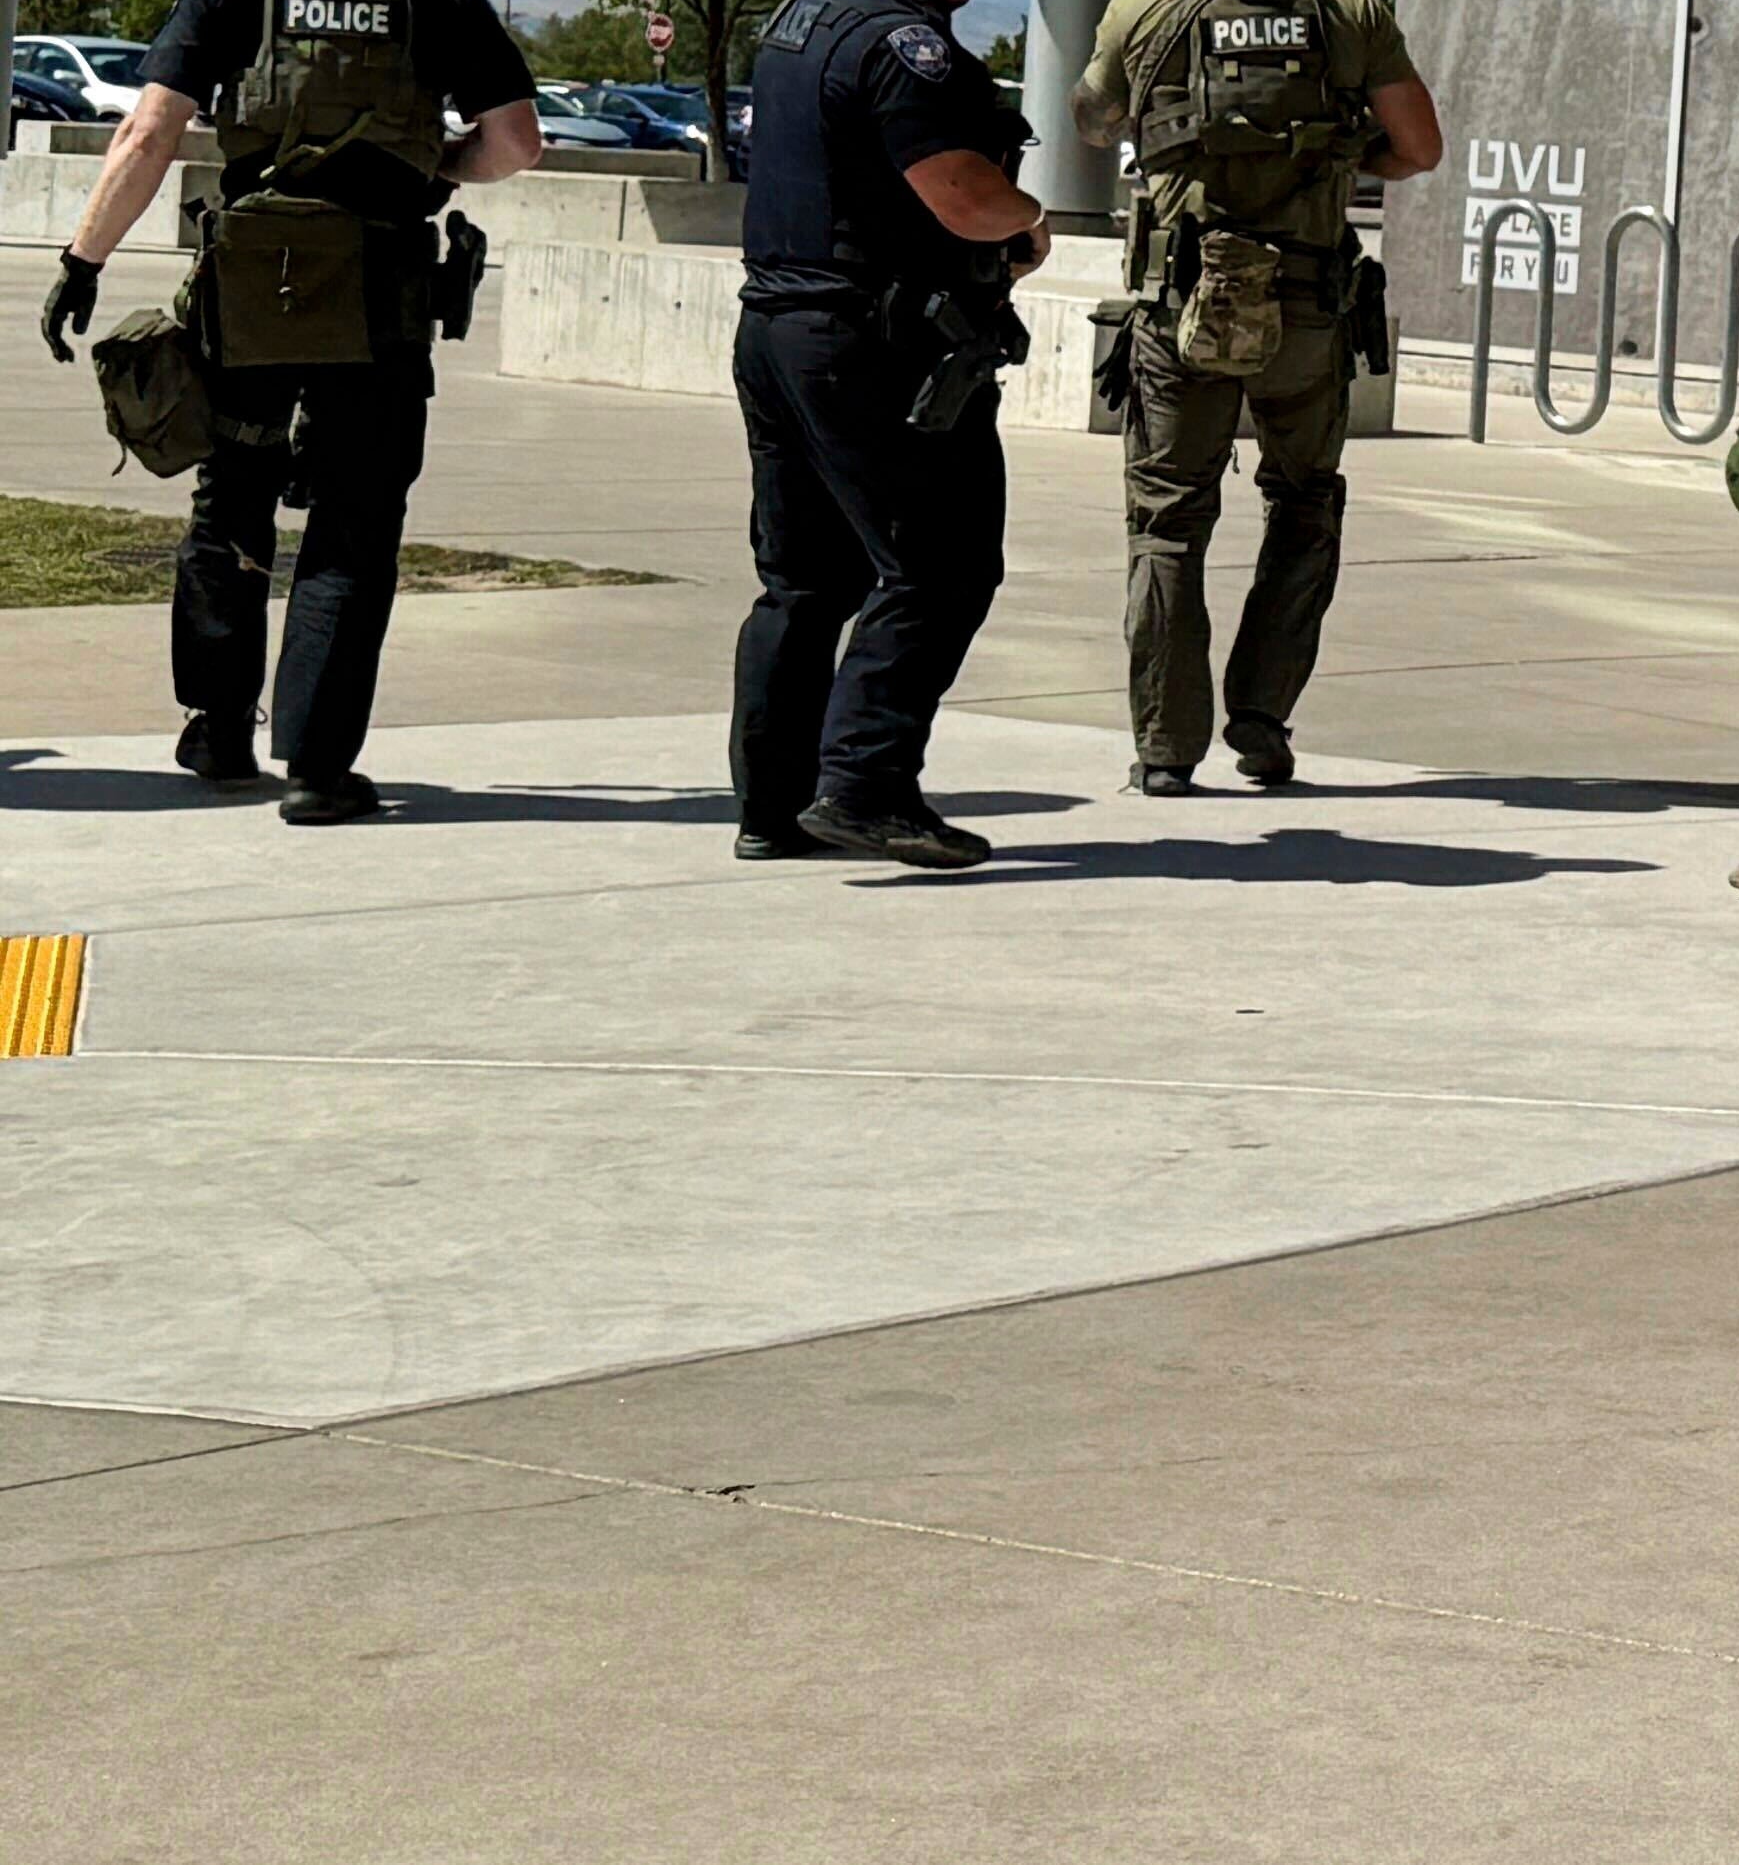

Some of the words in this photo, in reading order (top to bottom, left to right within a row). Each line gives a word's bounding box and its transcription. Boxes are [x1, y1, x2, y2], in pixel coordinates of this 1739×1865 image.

[1213, 16, 1307, 49] POLICE
[1468, 138, 1587, 197] UVU
[1469, 251, 1515, 281] FR
[1523, 255, 1570, 285] YU
